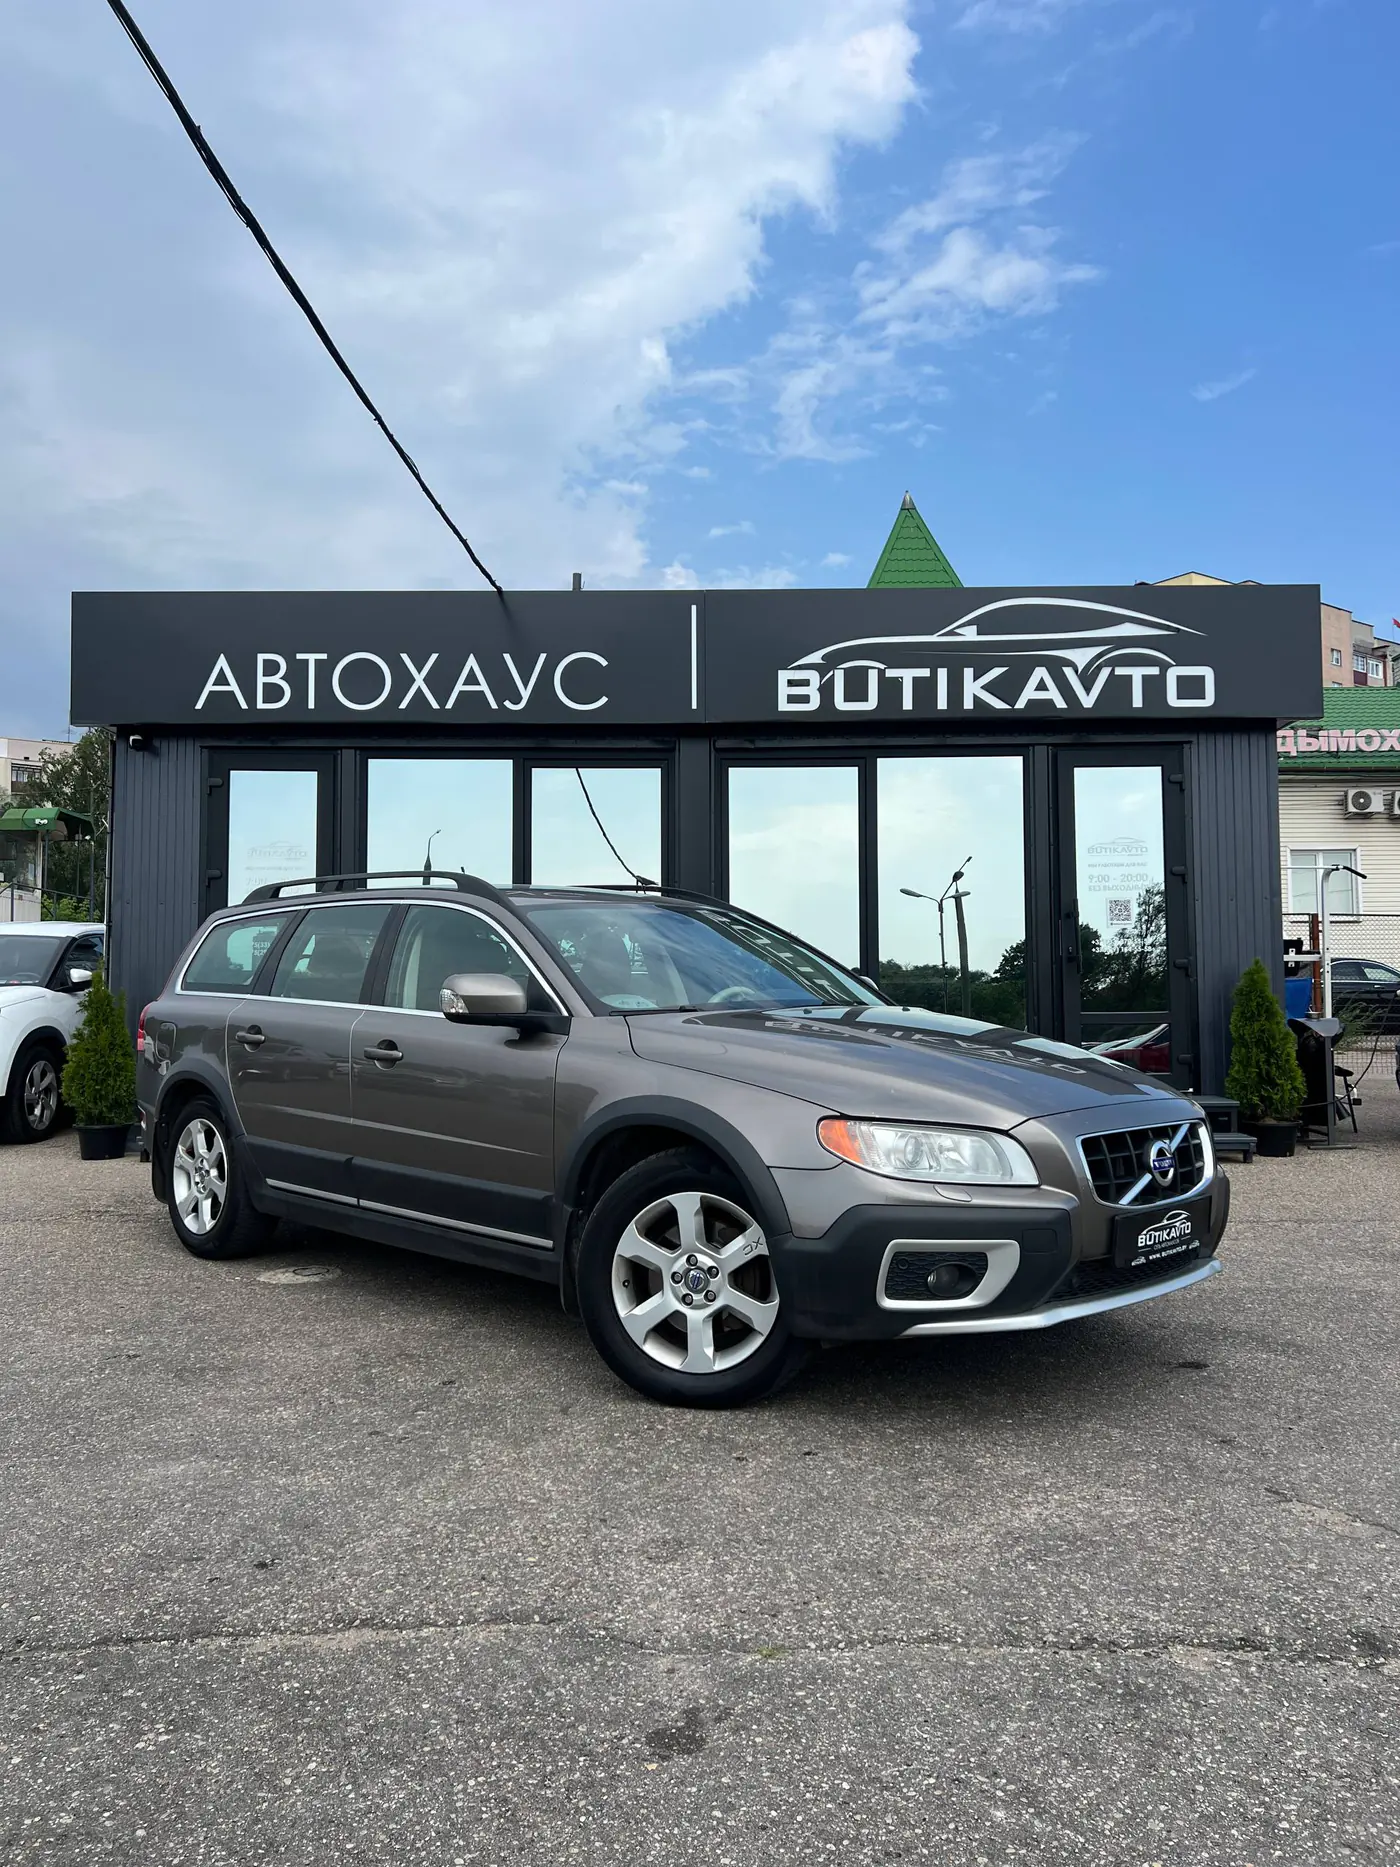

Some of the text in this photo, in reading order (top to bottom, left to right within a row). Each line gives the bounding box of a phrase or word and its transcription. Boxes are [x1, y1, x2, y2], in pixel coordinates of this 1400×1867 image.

[194, 651, 609, 711] АВТОХАУС
[777, 665, 1216, 712] BUTIKAVTO
[1087, 846, 1148, 854] BUTIKAVTO
[1088, 874, 1110, 883] 9:00
[1120, 873, 1148, 883] 20:00
[1138, 1222, 1191, 1246] BUTIKAVTO
